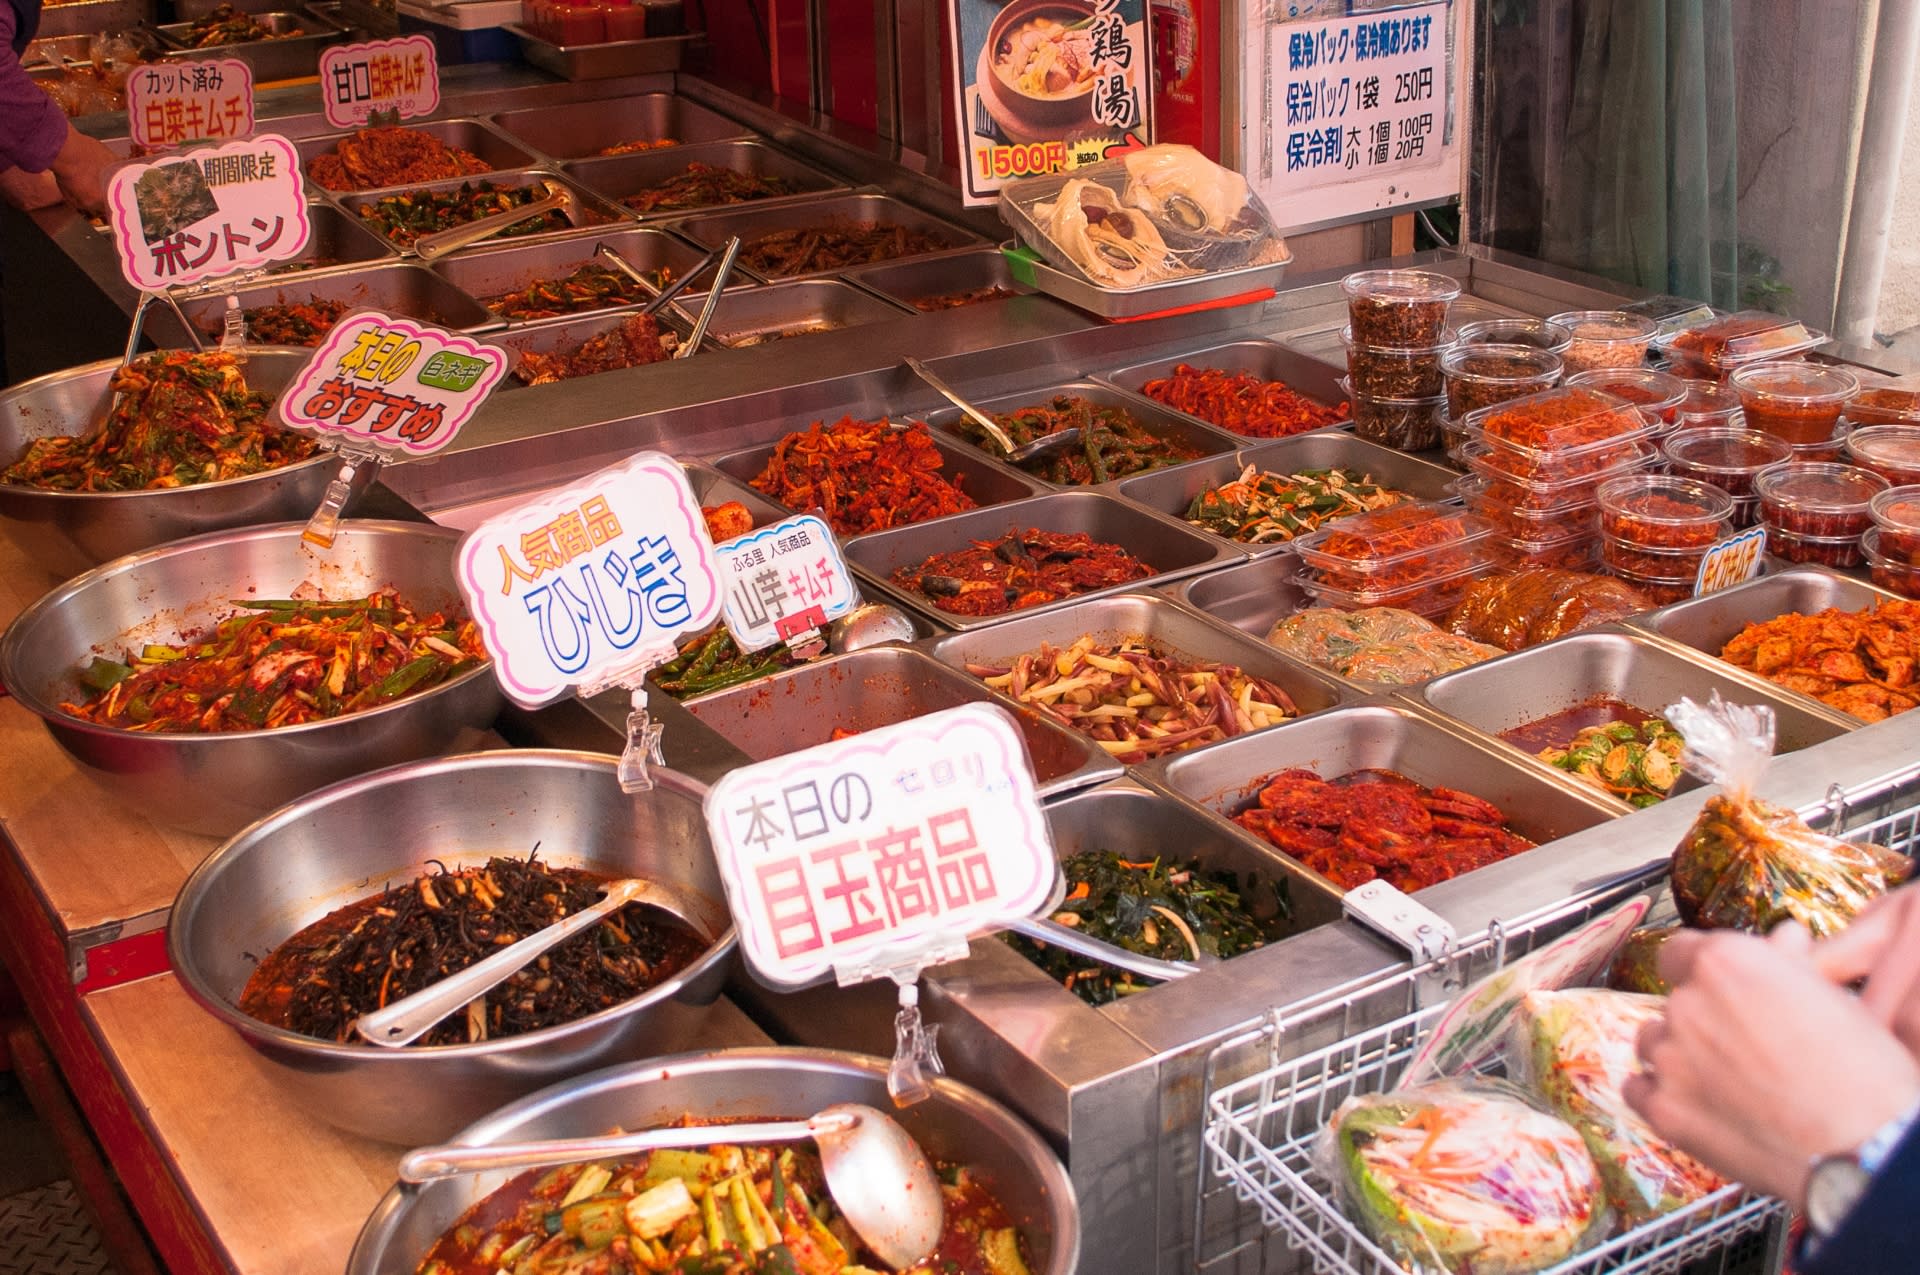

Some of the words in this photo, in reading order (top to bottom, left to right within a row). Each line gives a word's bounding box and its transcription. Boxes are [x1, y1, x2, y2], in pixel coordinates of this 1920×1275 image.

[145, 66, 224, 95] カット済み
[1355, 76, 1380, 110] 1袋
[1394, 67, 1432, 104] 250円
[145, 96, 243, 144] 白菜キムチ
[1346, 126, 1361, 148] 大
[1369, 121, 1391, 144] 1個
[1398, 113, 1432, 139] 100円
[203, 151, 276, 187] 期間限定
[977, 143, 1067, 176] 1500円
[1076, 152, 1099, 165] 当店の
[1286, 125, 1343, 172] 保冷剤
[1345, 148, 1360, 170] 小
[1367, 143, 1389, 166] 1個
[1394, 136, 1424, 161] 20円
[337, 326, 422, 385] 本日の
[423, 355, 483, 385] 白ネギ
[303, 376, 448, 443] おすすめ
[497, 494, 623, 596] 人気商品
[732, 548, 766, 573] ふる里
[770, 530, 811, 560] 人気商品
[522, 535, 692, 674] ひじき
[891, 751, 985, 793] セロリ
[735, 772, 873, 853] 本日の
[755, 807, 998, 960] 目玉商品
